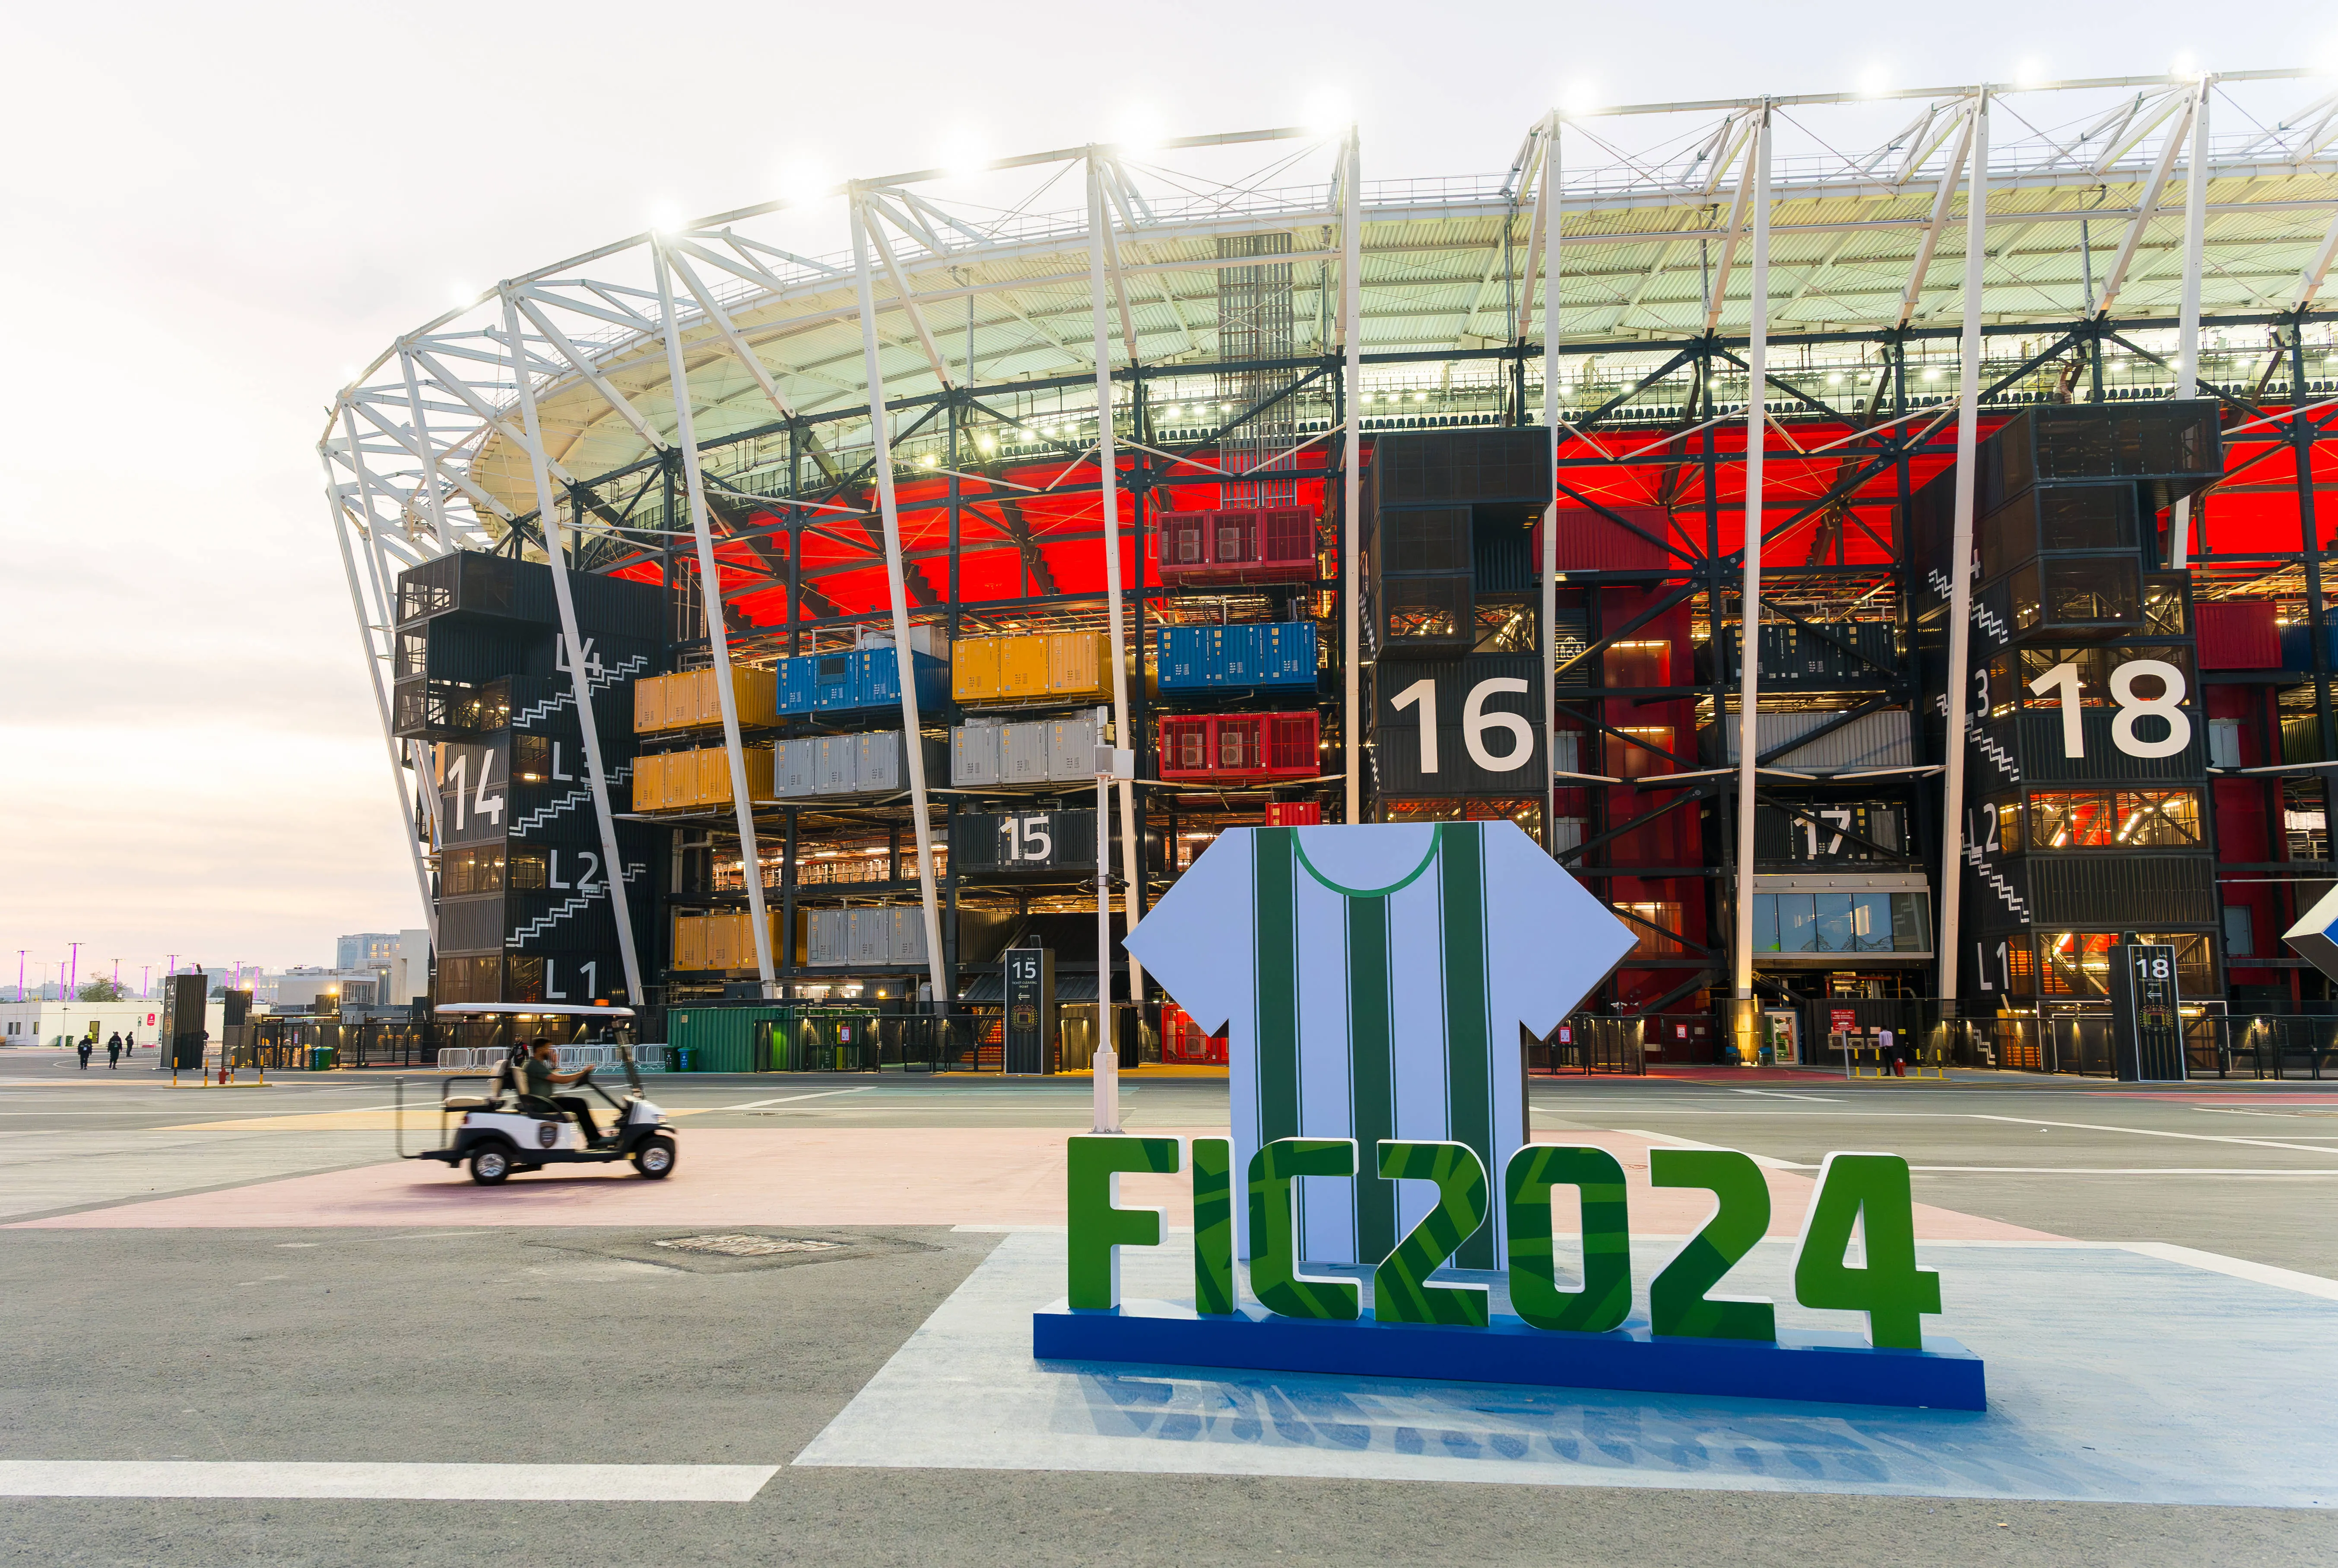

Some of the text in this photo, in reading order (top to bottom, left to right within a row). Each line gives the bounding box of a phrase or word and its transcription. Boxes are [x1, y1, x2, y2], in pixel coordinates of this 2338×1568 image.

[556, 633, 603, 676] L4
[1965, 669, 1989, 720] 3
[2029, 659, 2190, 757] 18
[1390, 678, 1534, 773] 16
[447, 748, 504, 830] 14
[1000, 816, 1051, 860] 15
[1793, 810, 1850, 855] 17
[1968, 803, 1999, 855] L2
[550, 849, 598, 890] L2
[546, 959, 596, 998] L1
[1012, 962, 1036, 978] 15
[1977, 941, 2009, 990] L1
[2136, 959, 2169, 978] 18
